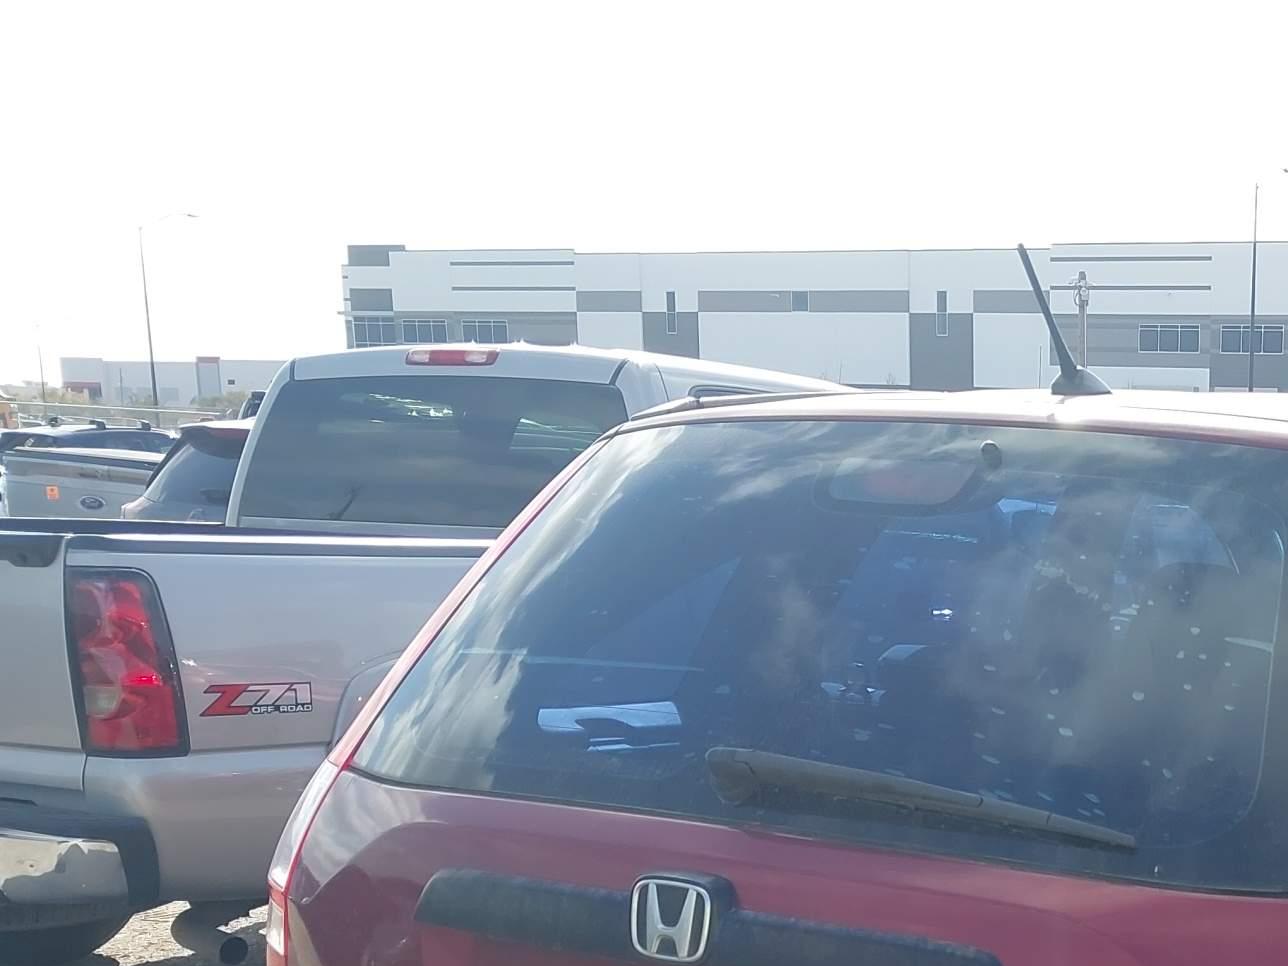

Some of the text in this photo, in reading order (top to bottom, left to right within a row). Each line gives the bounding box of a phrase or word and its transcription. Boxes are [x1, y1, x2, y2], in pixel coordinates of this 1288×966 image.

[200, 681, 312, 717] Z71
[251, 704, 313, 714] OFF ROAD
